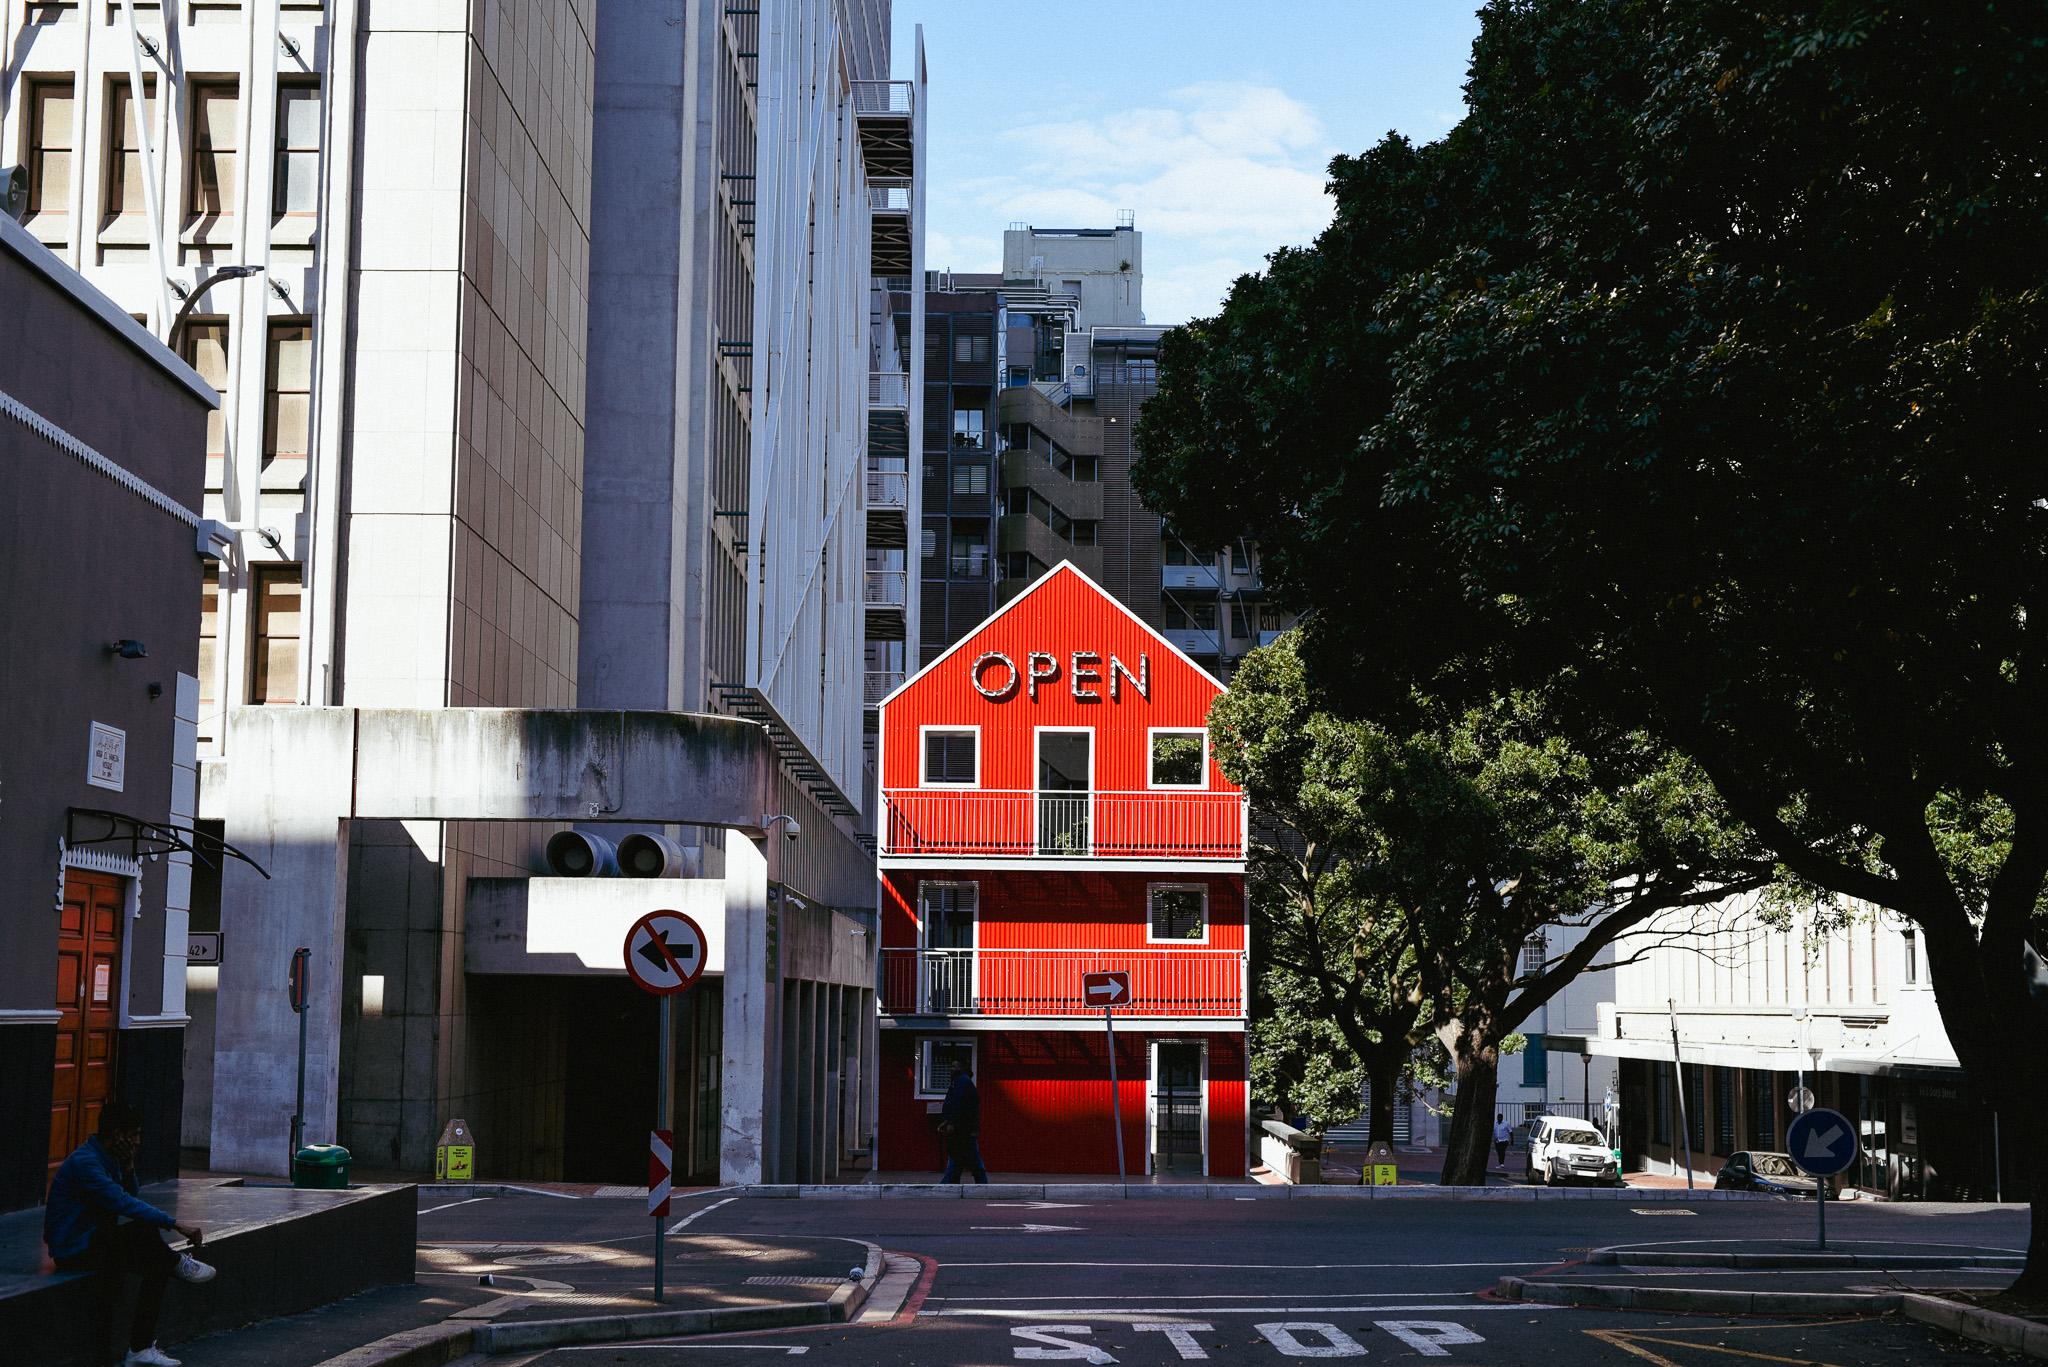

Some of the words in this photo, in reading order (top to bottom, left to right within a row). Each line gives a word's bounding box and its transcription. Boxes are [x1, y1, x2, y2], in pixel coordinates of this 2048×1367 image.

[971, 651, 1147, 697] OPEN
[188, 944, 201, 956] 42
[1009, 1320, 1486, 1360] STOP
